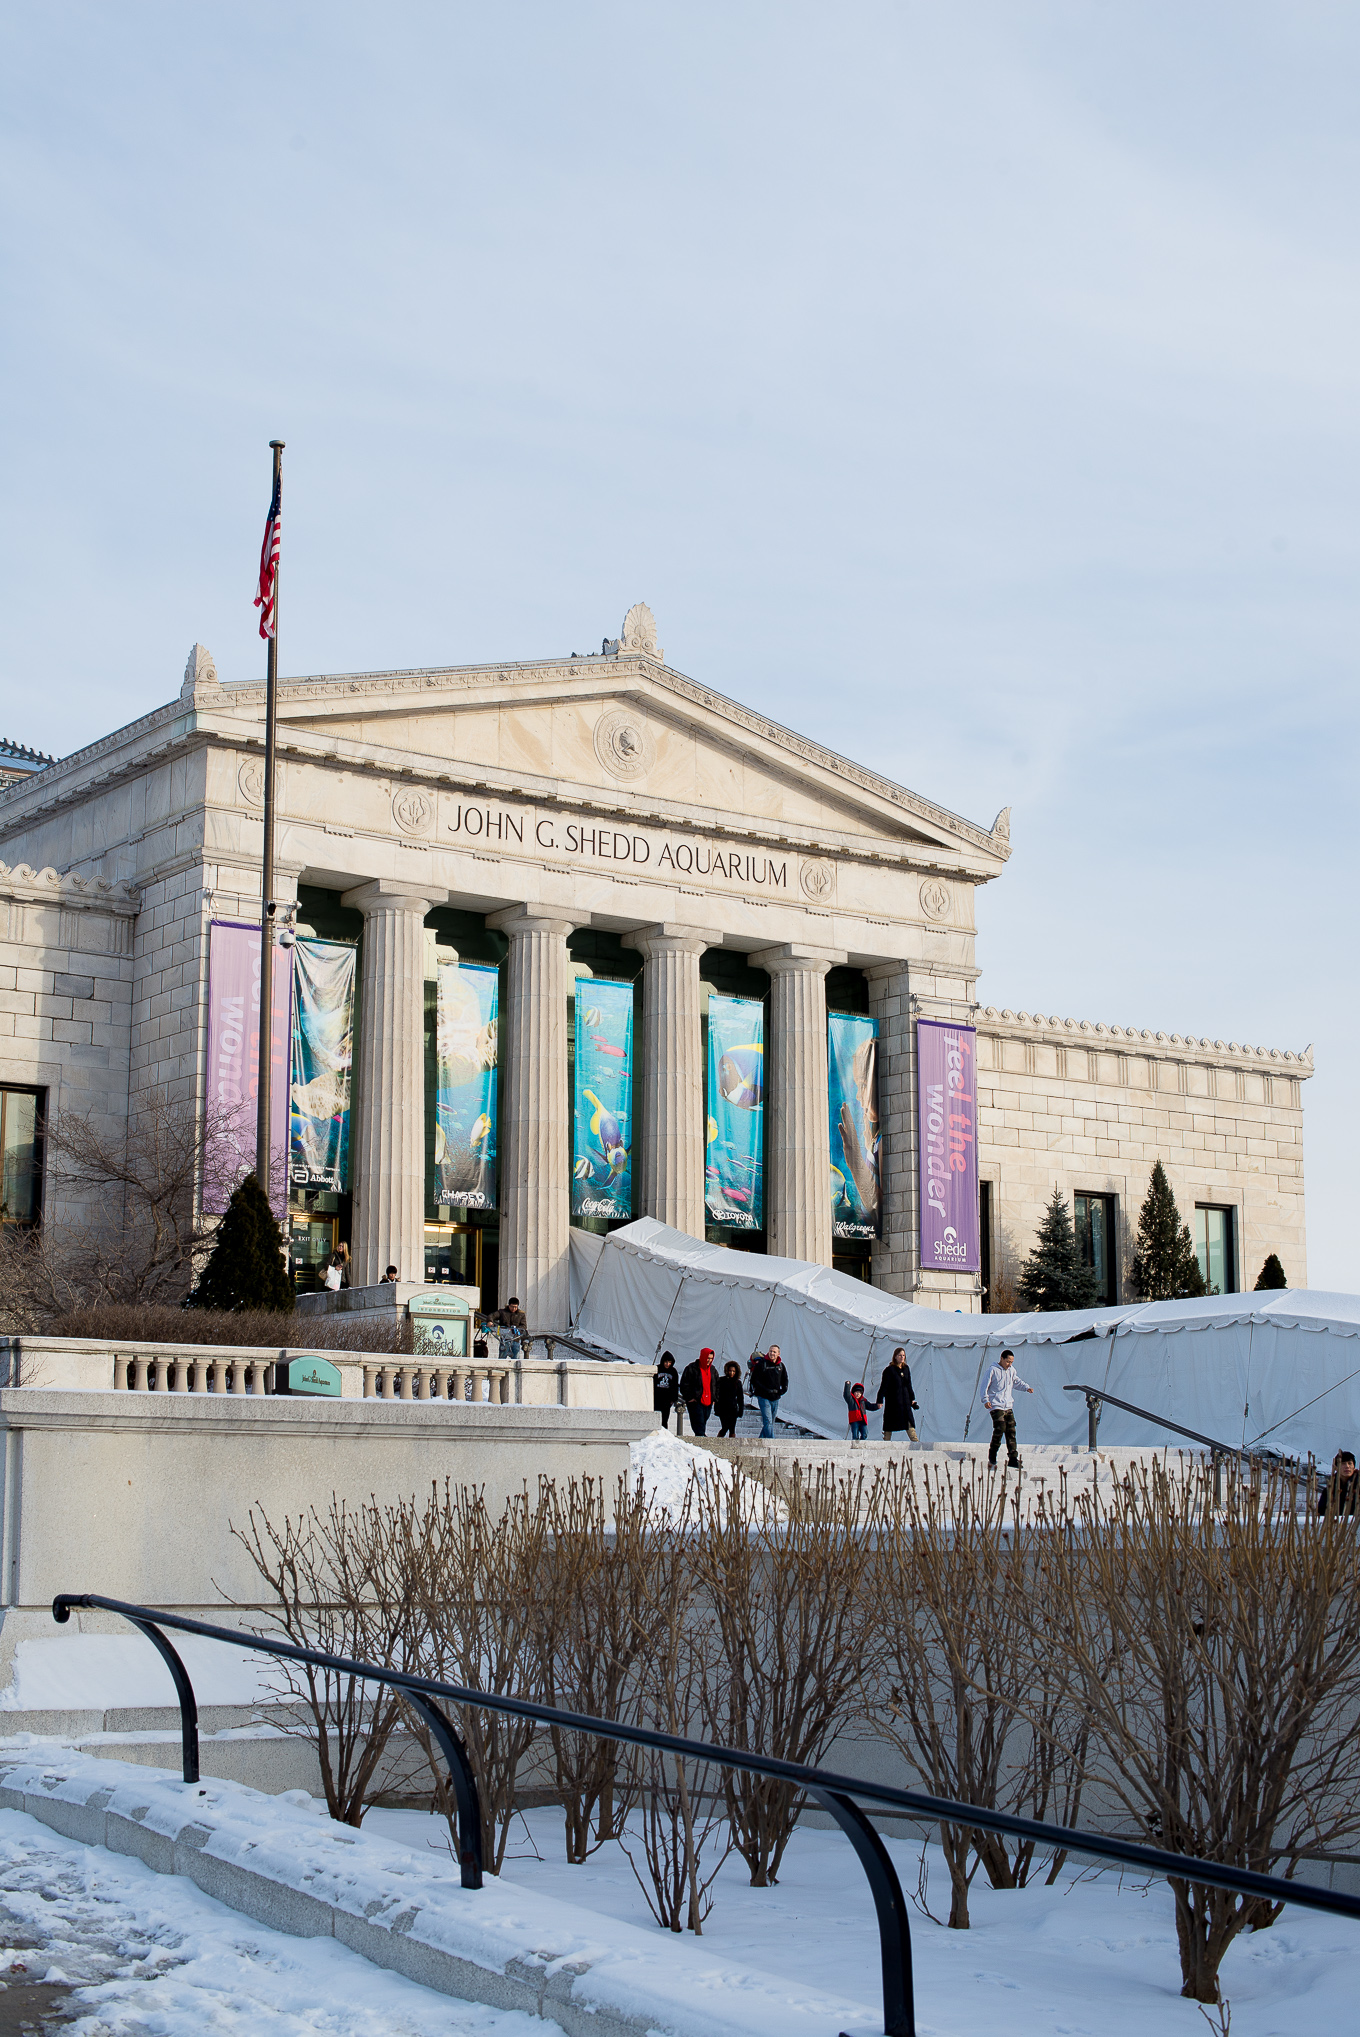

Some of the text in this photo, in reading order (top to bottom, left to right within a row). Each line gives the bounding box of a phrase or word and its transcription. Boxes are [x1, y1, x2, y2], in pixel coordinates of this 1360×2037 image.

[447, 805, 788, 888] JOHN G. SHEDD AQUARIUM
[943, 1035, 973, 1173] feel the
[926, 1084, 952, 1218] wonder
[310, 1174, 335, 1184] Abbott
[441, 1189, 475, 1201] CHASE
[725, 1211, 754, 1222] TOYOTA
[835, 1221, 875, 1233] Walgreens
[933, 1241, 967, 1257] Shedd
[934, 1255, 967, 1263] AQUARIUM
